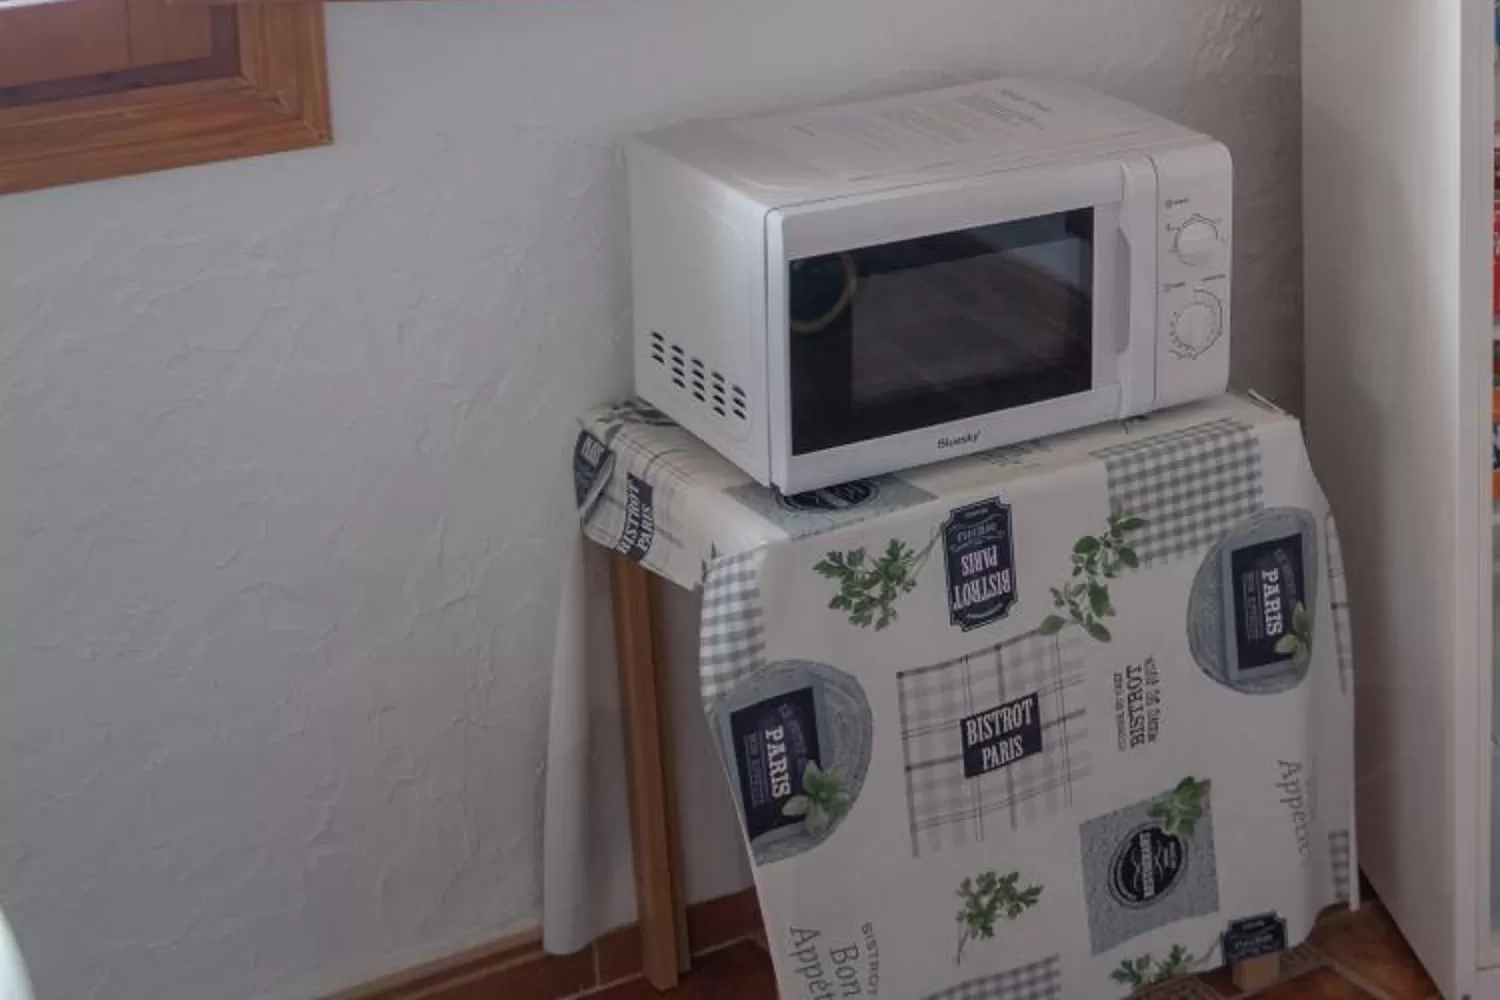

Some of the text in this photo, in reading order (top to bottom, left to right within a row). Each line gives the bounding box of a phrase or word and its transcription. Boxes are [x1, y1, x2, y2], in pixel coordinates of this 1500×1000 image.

[936, 429, 981, 449] Bluesky
[960, 544, 999, 576] PARIS
[951, 567, 1011, 609] BISTROT
[1261, 567, 1284, 636] PARIS
[966, 698, 1034, 746] BISTROT
[1125, 664, 1145, 749] BISTROT
[763, 724, 792, 799] PARIS
[981, 734, 1024, 770] PARIS
[828, 943, 862, 998] Bon
